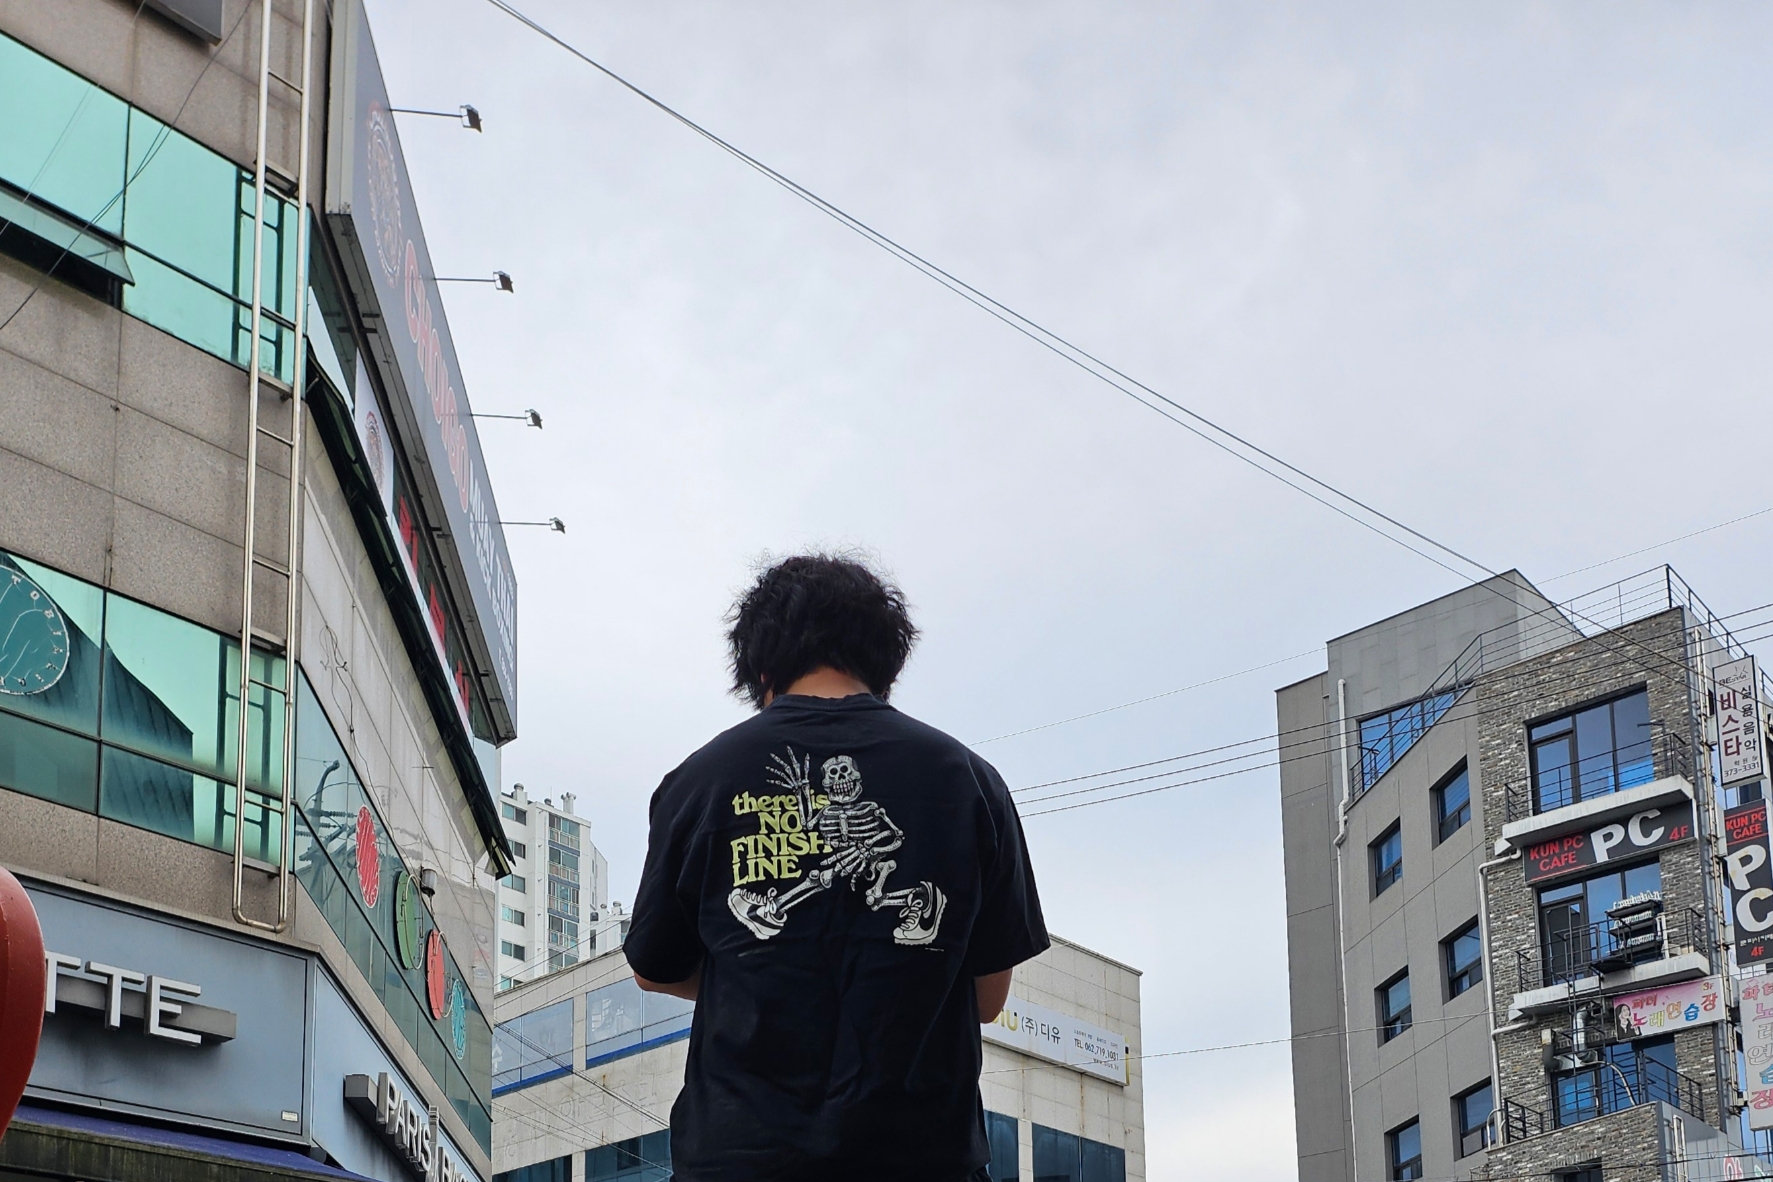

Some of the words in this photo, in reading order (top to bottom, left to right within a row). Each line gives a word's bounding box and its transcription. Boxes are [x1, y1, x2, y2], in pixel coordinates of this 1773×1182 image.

[496, 552, 514, 640] THAI
[1720, 689, 1742, 757] 비스타
[1740, 685, 1757, 751] 실용음악
[732, 791, 798, 815] there
[811, 789, 831, 810] is
[758, 810, 803, 834] NO
[1590, 808, 1665, 864] PC
[1668, 825, 1688, 842] 4F
[1726, 816, 1749, 831] KUN
[1751, 810, 1767, 824] PC
[1733, 823, 1762, 841] CAFE
[731, 831, 834, 864] FINISH
[1529, 841, 1559, 861] KUN
[1562, 835, 1584, 850] PC
[1539, 852, 1577, 872] CAFE
[733, 855, 803, 888] LINE
[1724, 844, 1773, 933] PC
[1751, 945, 1764, 957] 4F
[1632, 991, 1718, 1027] 노래연습장
[377, 1071, 432, 1173] PARIS
